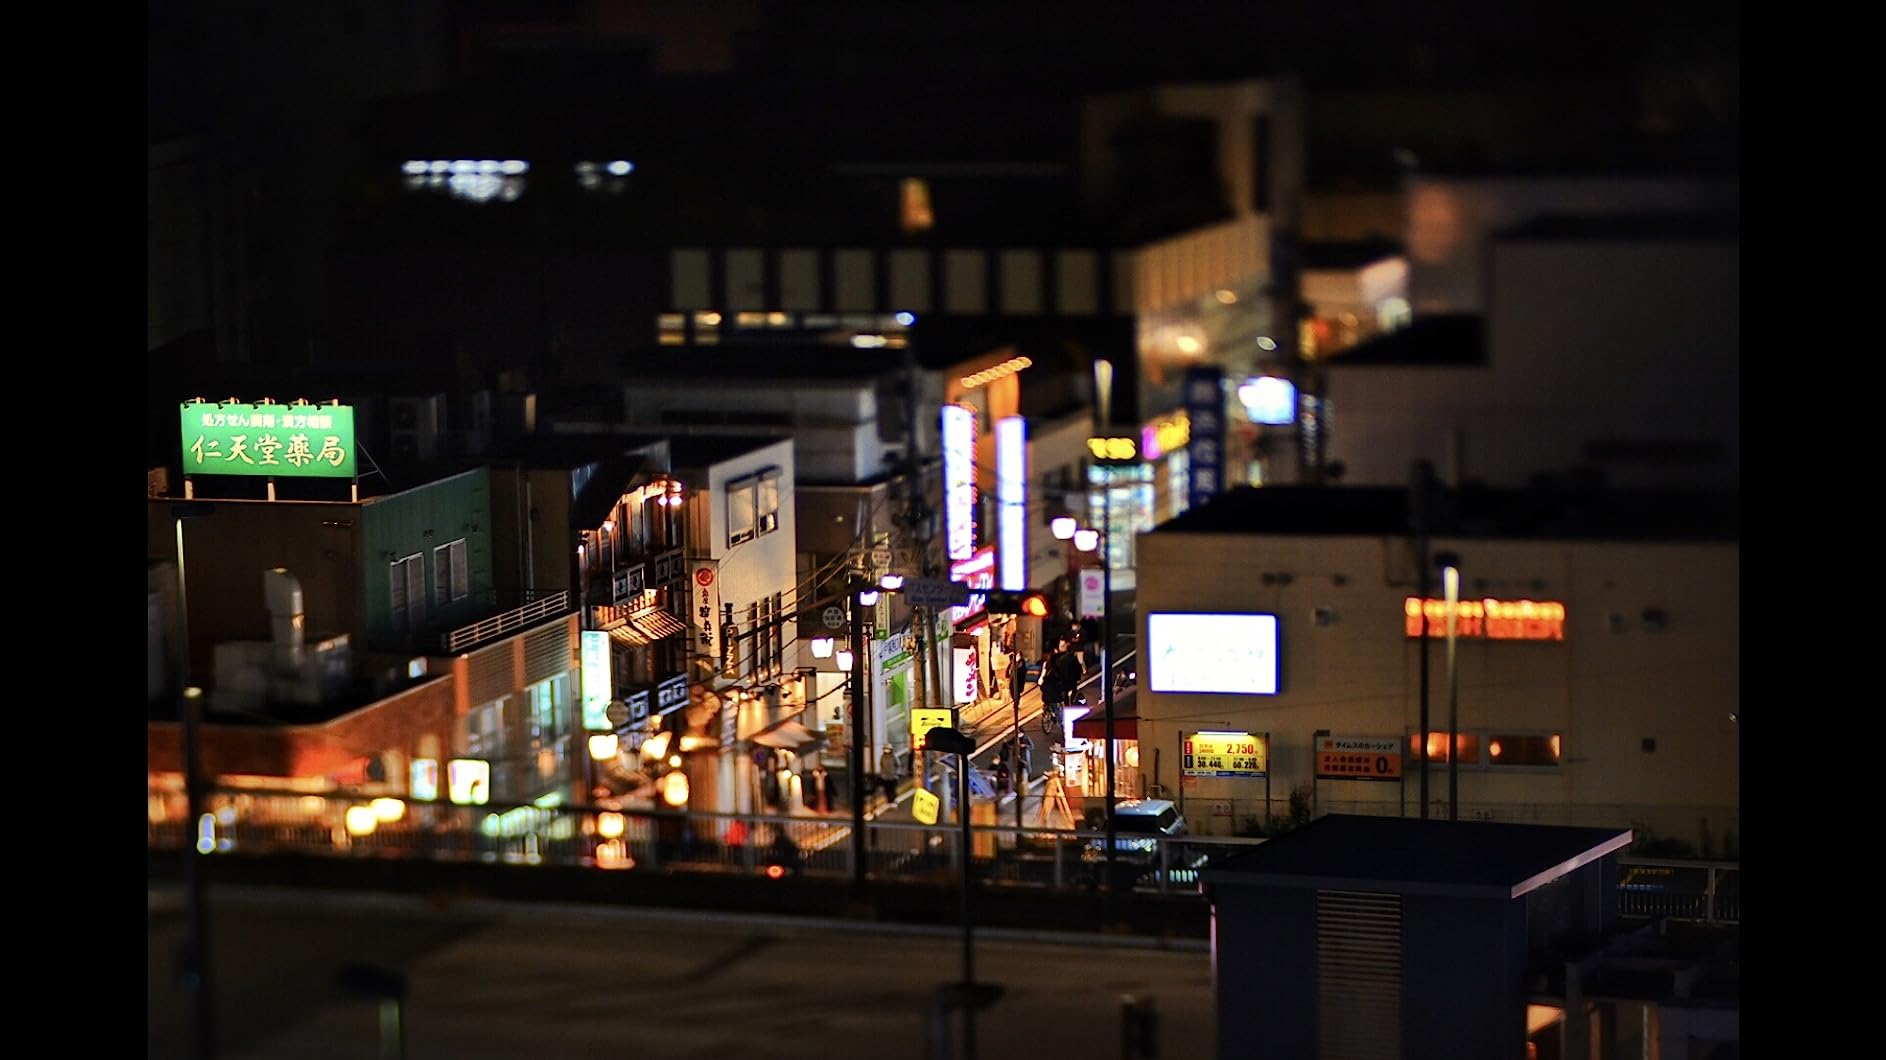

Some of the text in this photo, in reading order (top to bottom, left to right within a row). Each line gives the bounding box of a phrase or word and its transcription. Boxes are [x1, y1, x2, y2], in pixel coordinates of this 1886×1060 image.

[202, 413, 332, 429] 処方せん・方
[191, 433, 345, 467] 仁天堂薬局
